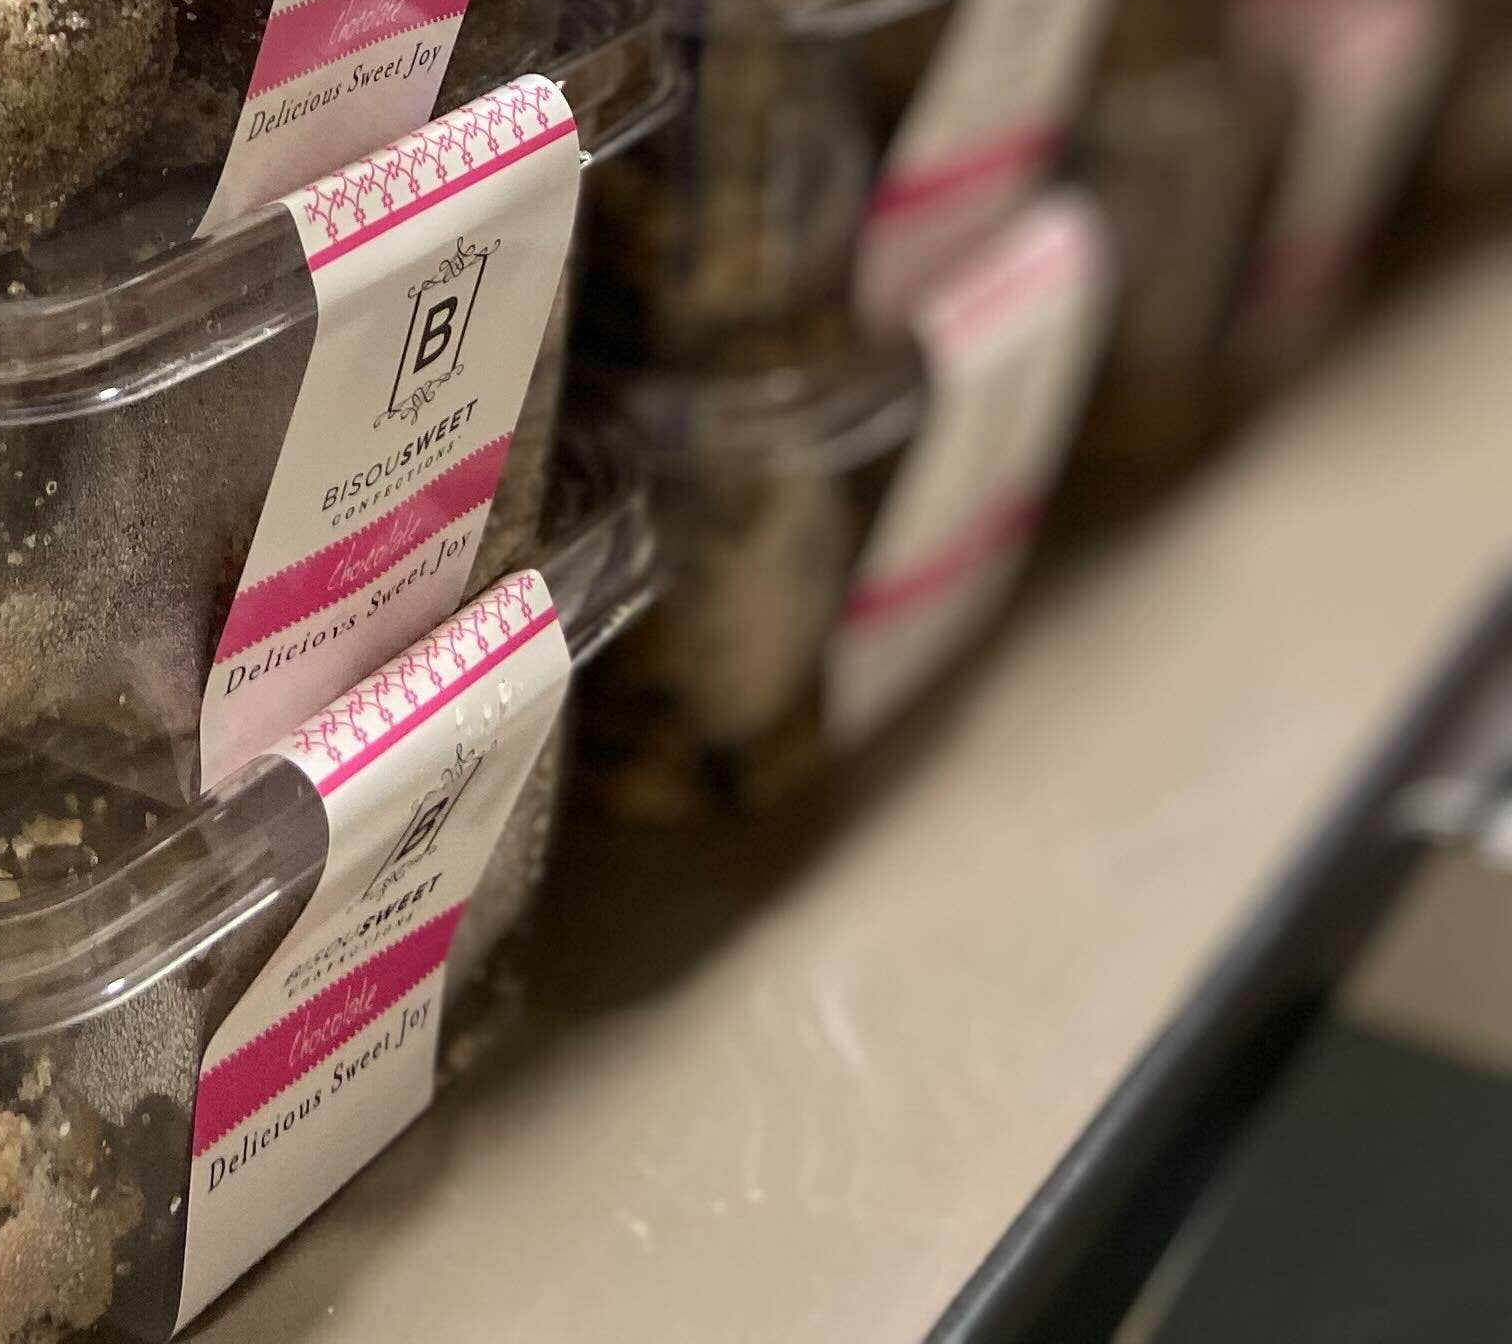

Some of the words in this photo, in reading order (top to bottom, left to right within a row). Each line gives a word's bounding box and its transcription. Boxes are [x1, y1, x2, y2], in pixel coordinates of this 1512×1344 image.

[246, 81, 343, 143] Delicious
[346, 55, 404, 94] Sweet
[403, 41, 443, 80] Joy
[412, 294, 458, 377] B
[320, 397, 479, 513] BISOUSWEET
[366, 559, 428, 618] Sweet
[429, 530, 473, 576] Joy
[207, 1088, 323, 1194] Delicious
[330, 1032, 392, 1094] Sweet
[395, 997, 432, 1049] Joy
